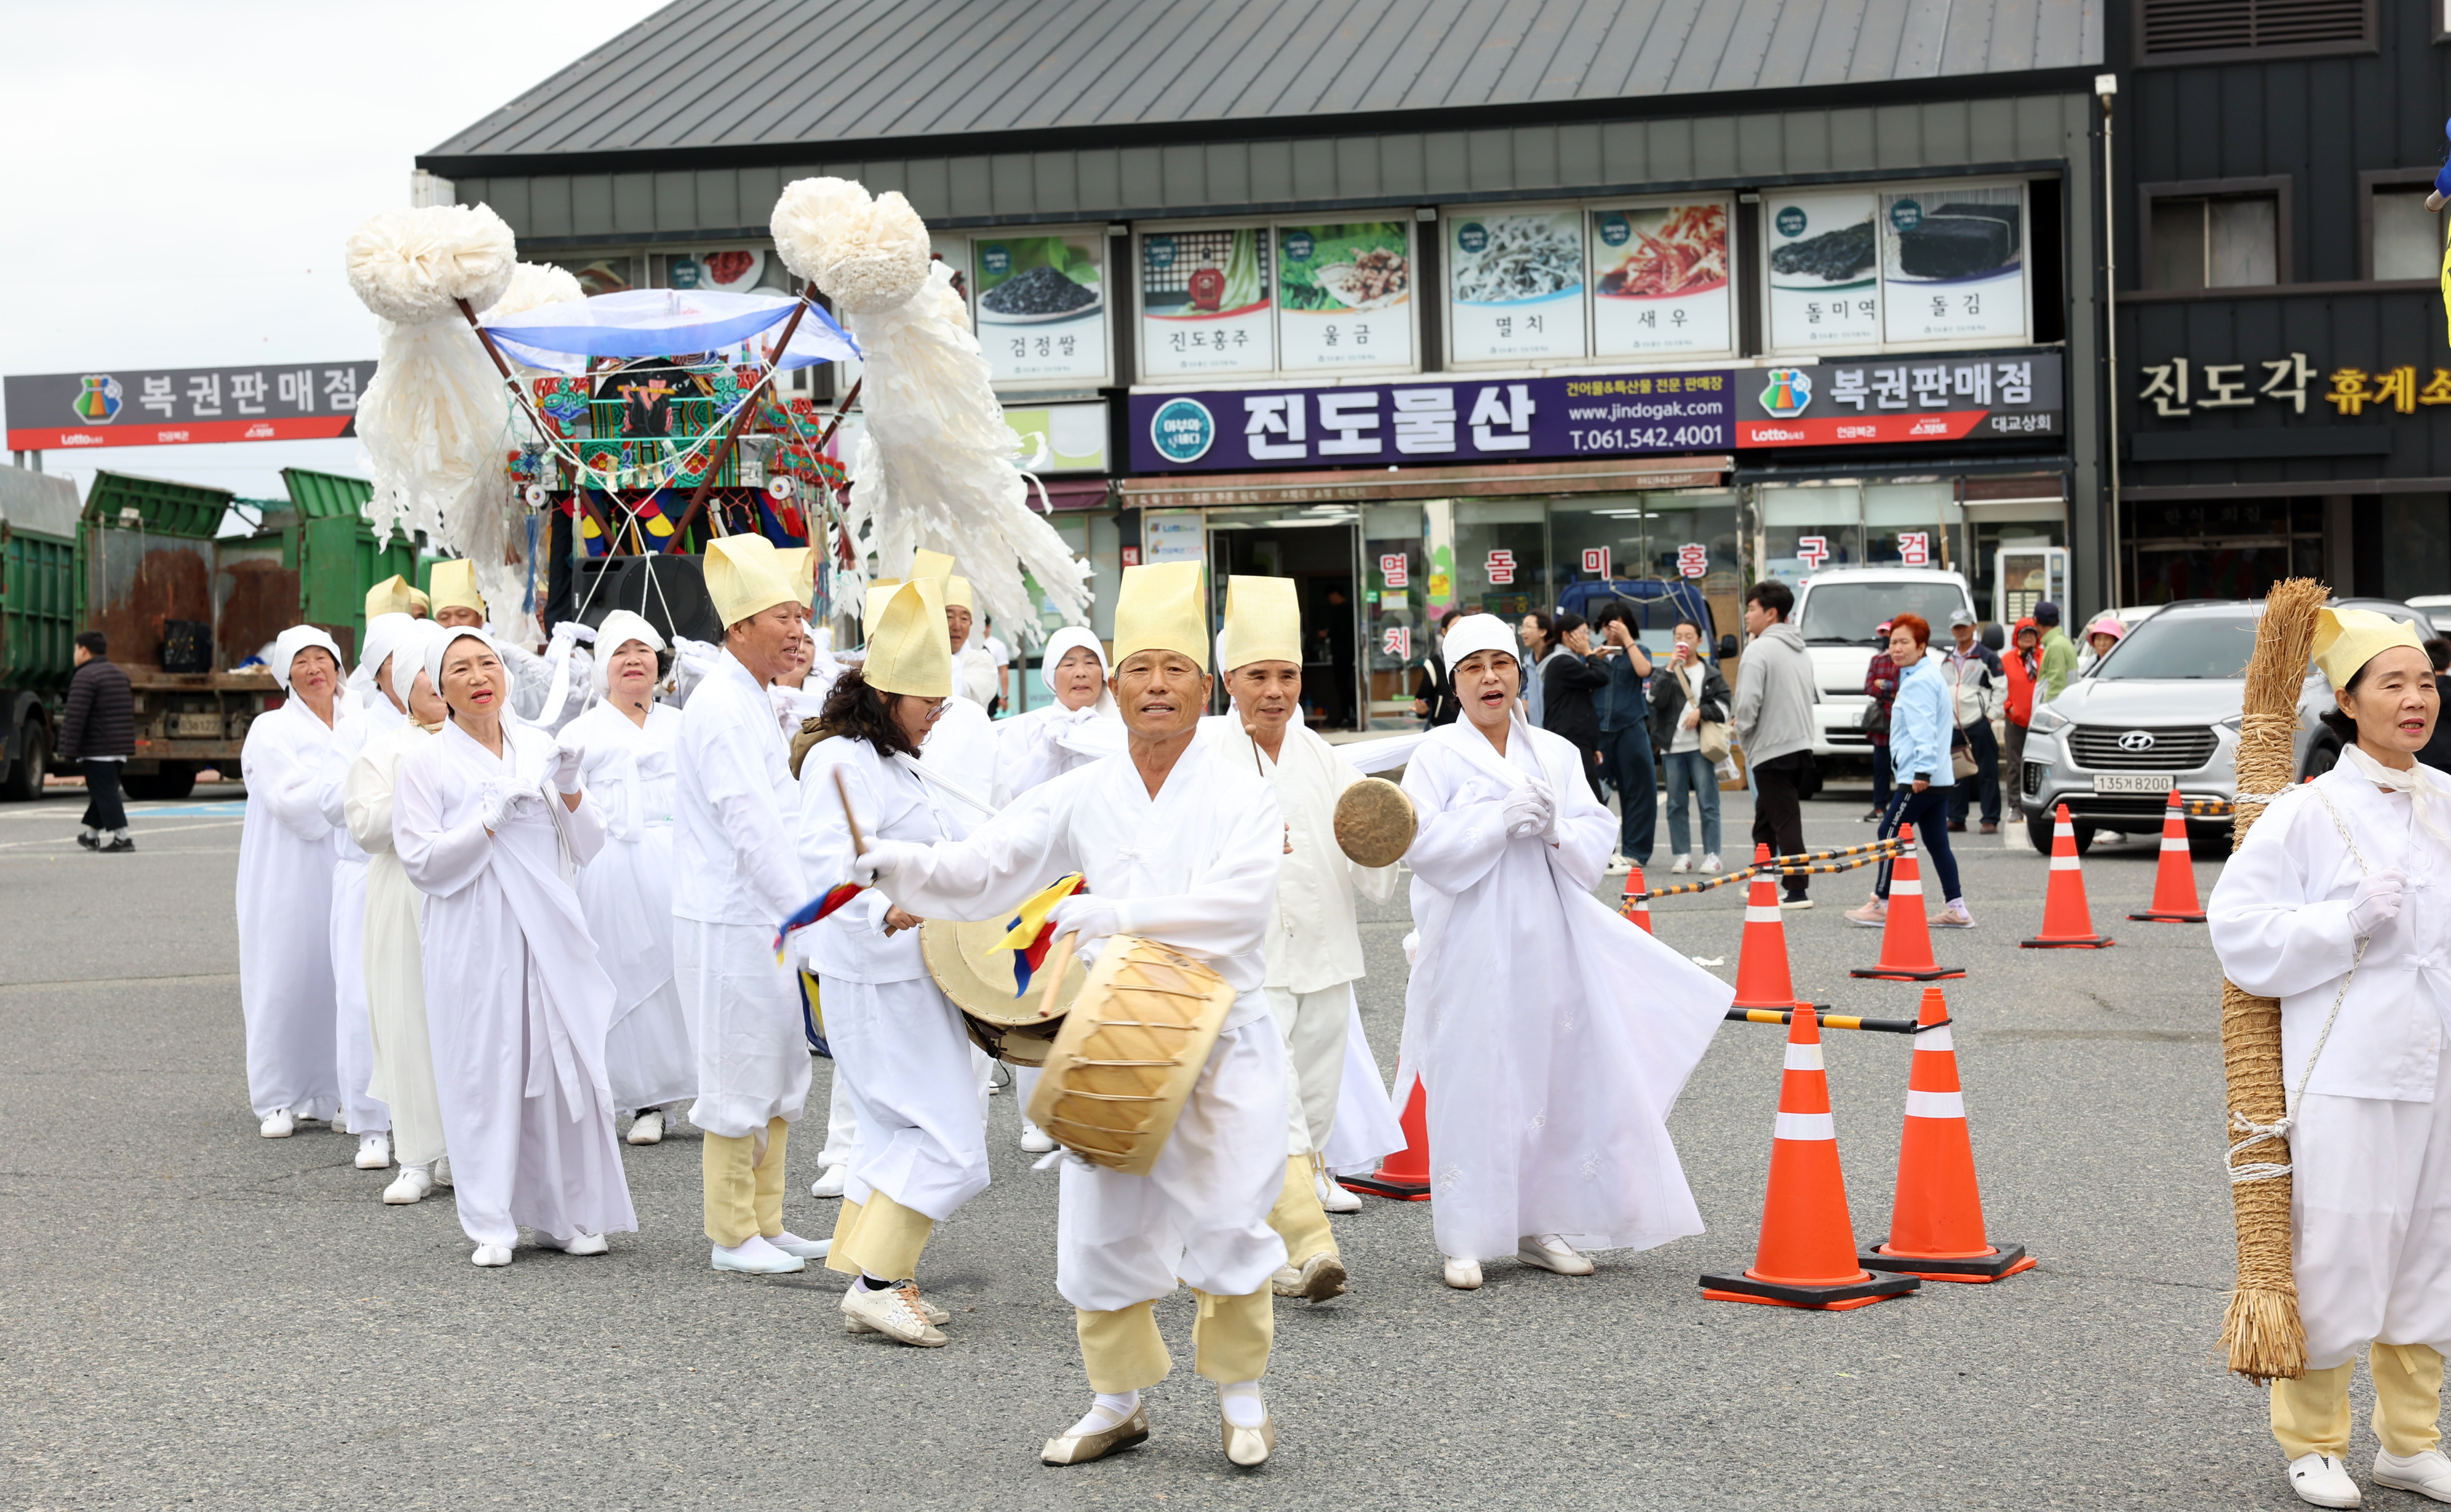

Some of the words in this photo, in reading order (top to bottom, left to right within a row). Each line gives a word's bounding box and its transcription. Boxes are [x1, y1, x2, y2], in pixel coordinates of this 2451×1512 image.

[1805, 299, 1875, 324] 돌미역
[1929, 293, 1980, 317] 돌김
[1496, 315, 1543, 338] 멸치
[1637, 309, 1688, 328] 새우
[1010, 335, 1077, 357] 검정쌀
[1170, 329, 1249, 352] 진도홍주
[1322, 324, 1371, 346] 울금
[140, 368, 357, 417] 복권판매점
[1566, 379, 1652, 397] 건어물&특산물
[1656, 378, 1681, 393] 전문
[1684, 376, 1723, 392] 판매장
[1830, 362, 2032, 410] 복권판매점
[2138, 352, 2317, 416] 진도각
[2325, 364, 2451, 415] 휴게소
[1244, 385, 1536, 460] 진도물산
[1569, 401, 1723, 422] www.jindogak.com
[1991, 414, 2051, 433] 대교상회
[1569, 424, 1722, 451] T.061.542.4001
